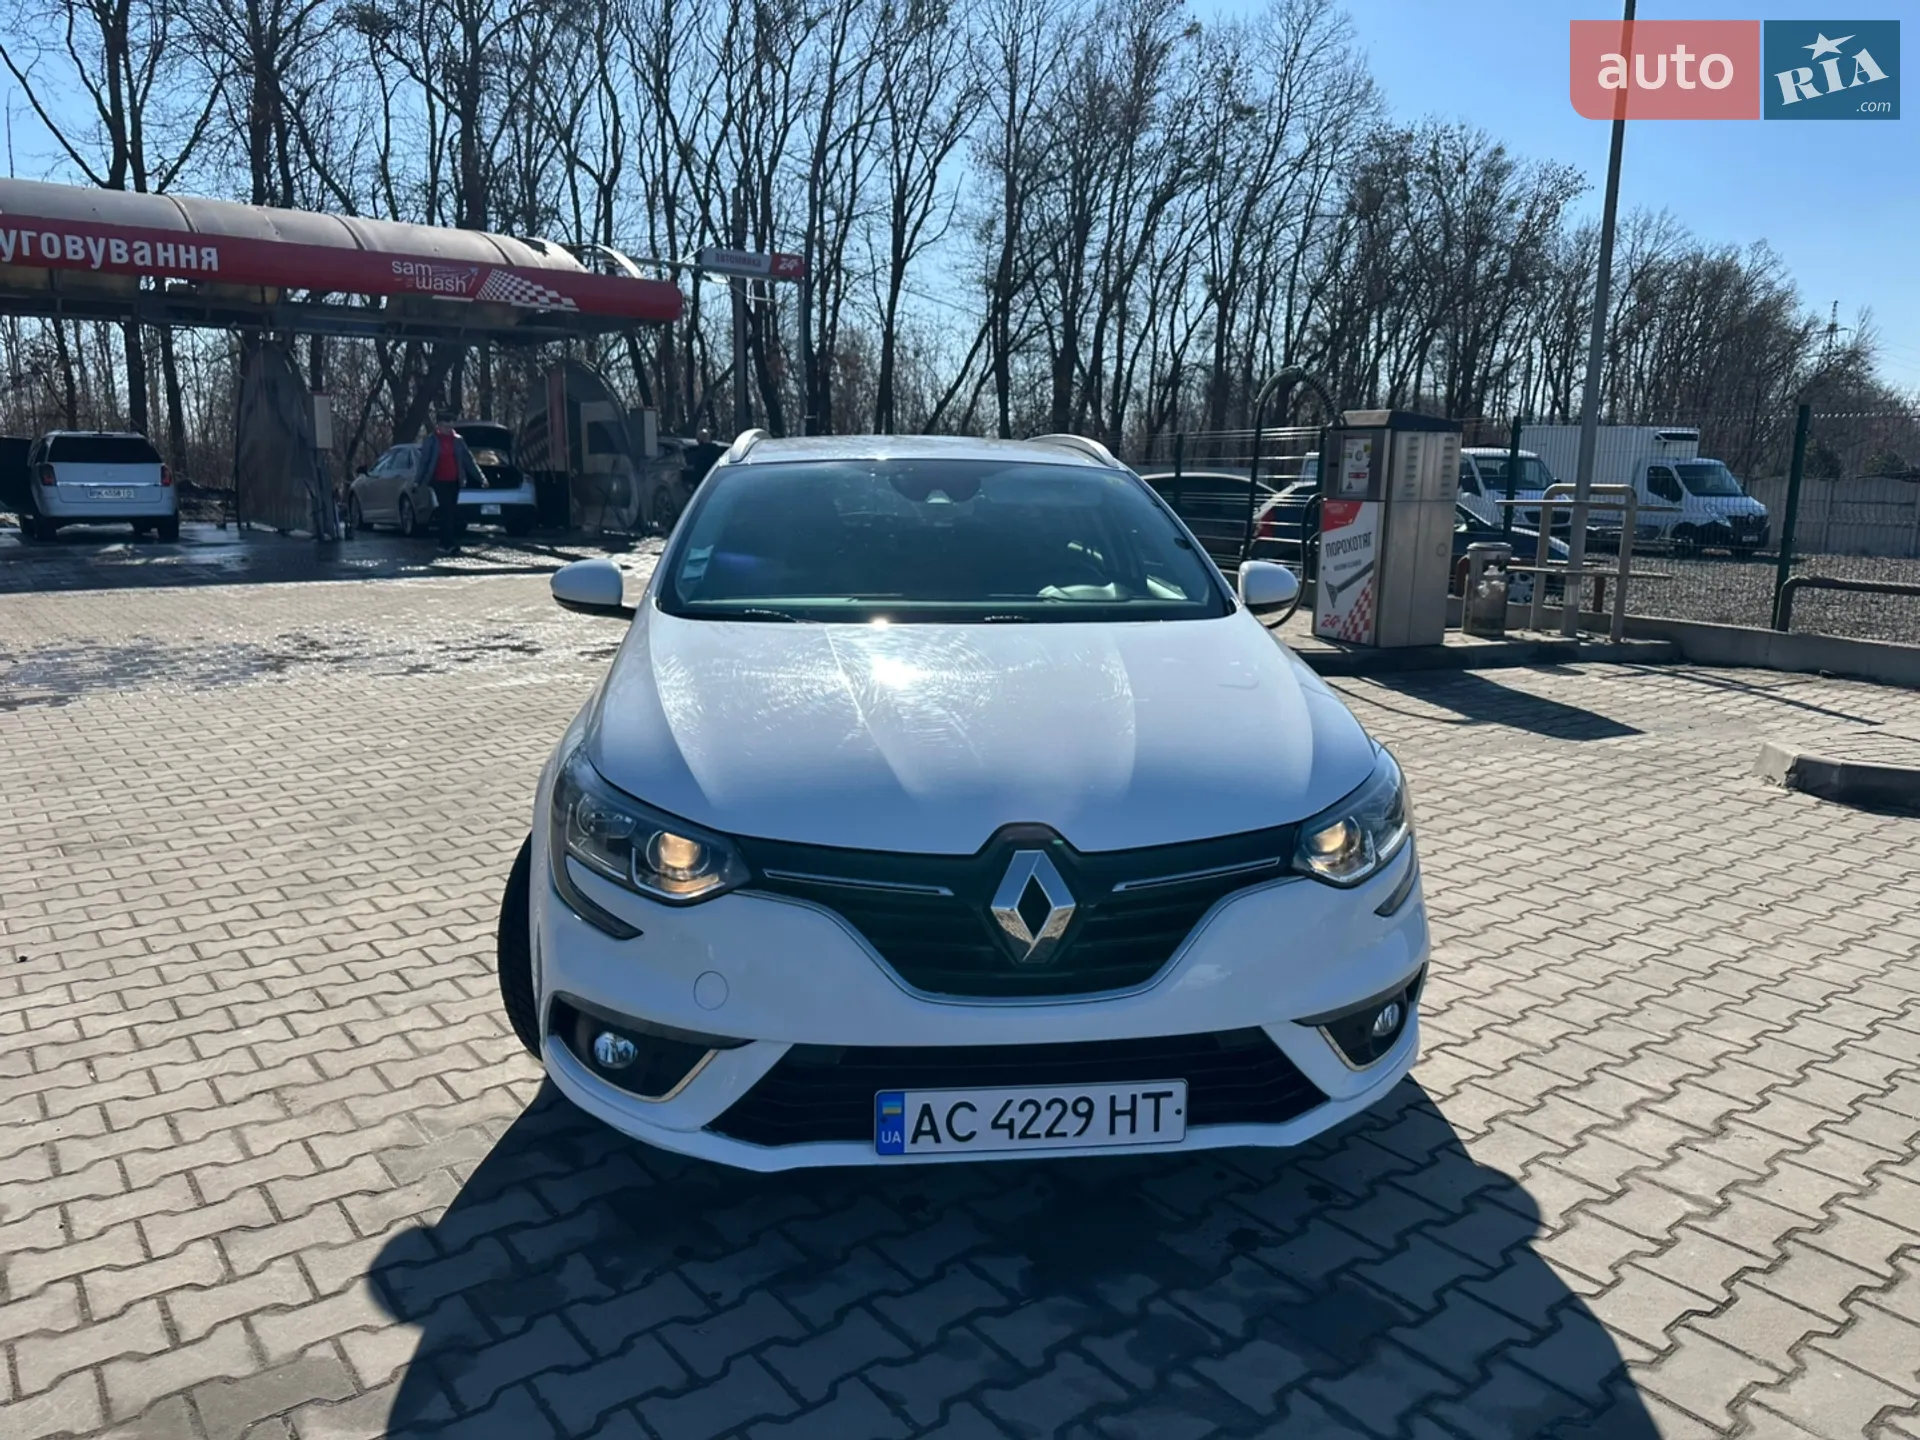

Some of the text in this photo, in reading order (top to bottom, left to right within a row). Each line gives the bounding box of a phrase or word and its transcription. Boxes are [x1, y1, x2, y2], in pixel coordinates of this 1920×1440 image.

[0, 227, 219, 272] уговування
[391, 260, 432, 276] sam
[1325, 531, 1372, 558] ПОРОХОТЯГ
[910, 1090, 1173, 1144] AC 4229 HT
[881, 1130, 902, 1144] UA
